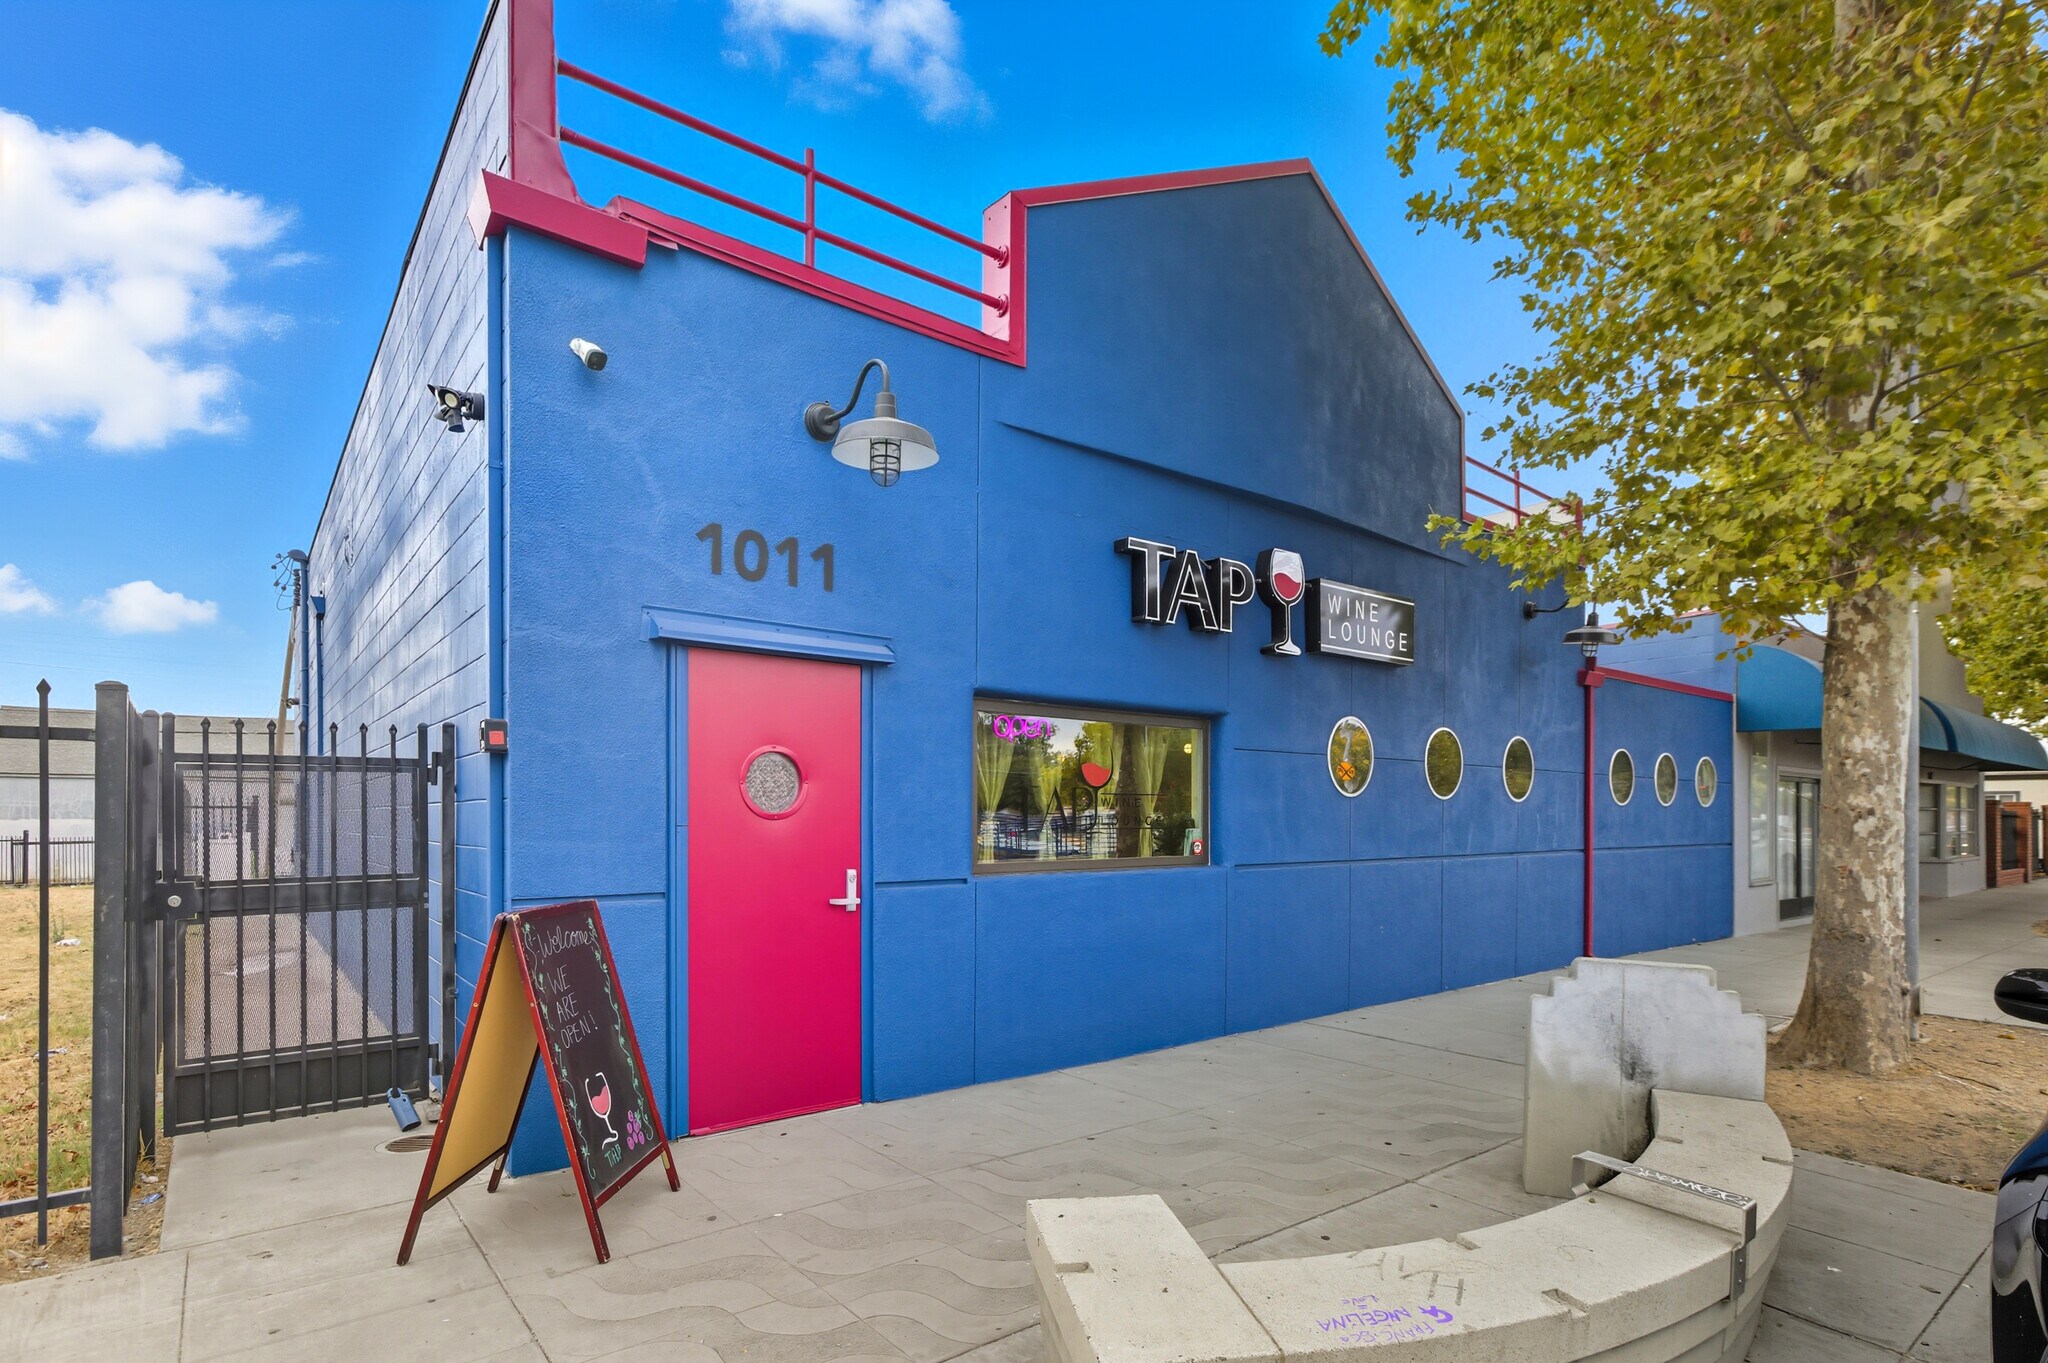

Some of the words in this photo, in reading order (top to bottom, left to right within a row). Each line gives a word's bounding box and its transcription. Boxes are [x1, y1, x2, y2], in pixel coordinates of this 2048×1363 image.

[695, 522, 835, 592] 1011
[1114, 536, 1256, 633] TAP
[1328, 593, 1379, 622] WINE
[1329, 621, 1408, 652] LOUNGE
[993, 714, 1051, 743] open
[1013, 785, 1094, 833] TAP
[1100, 796, 1142, 808] WINE
[537, 926, 593, 958] Welcome
[547, 964, 571, 994] WE
[556, 992, 579, 1024] ARE
[560, 1010, 598, 1049] OPEN!
